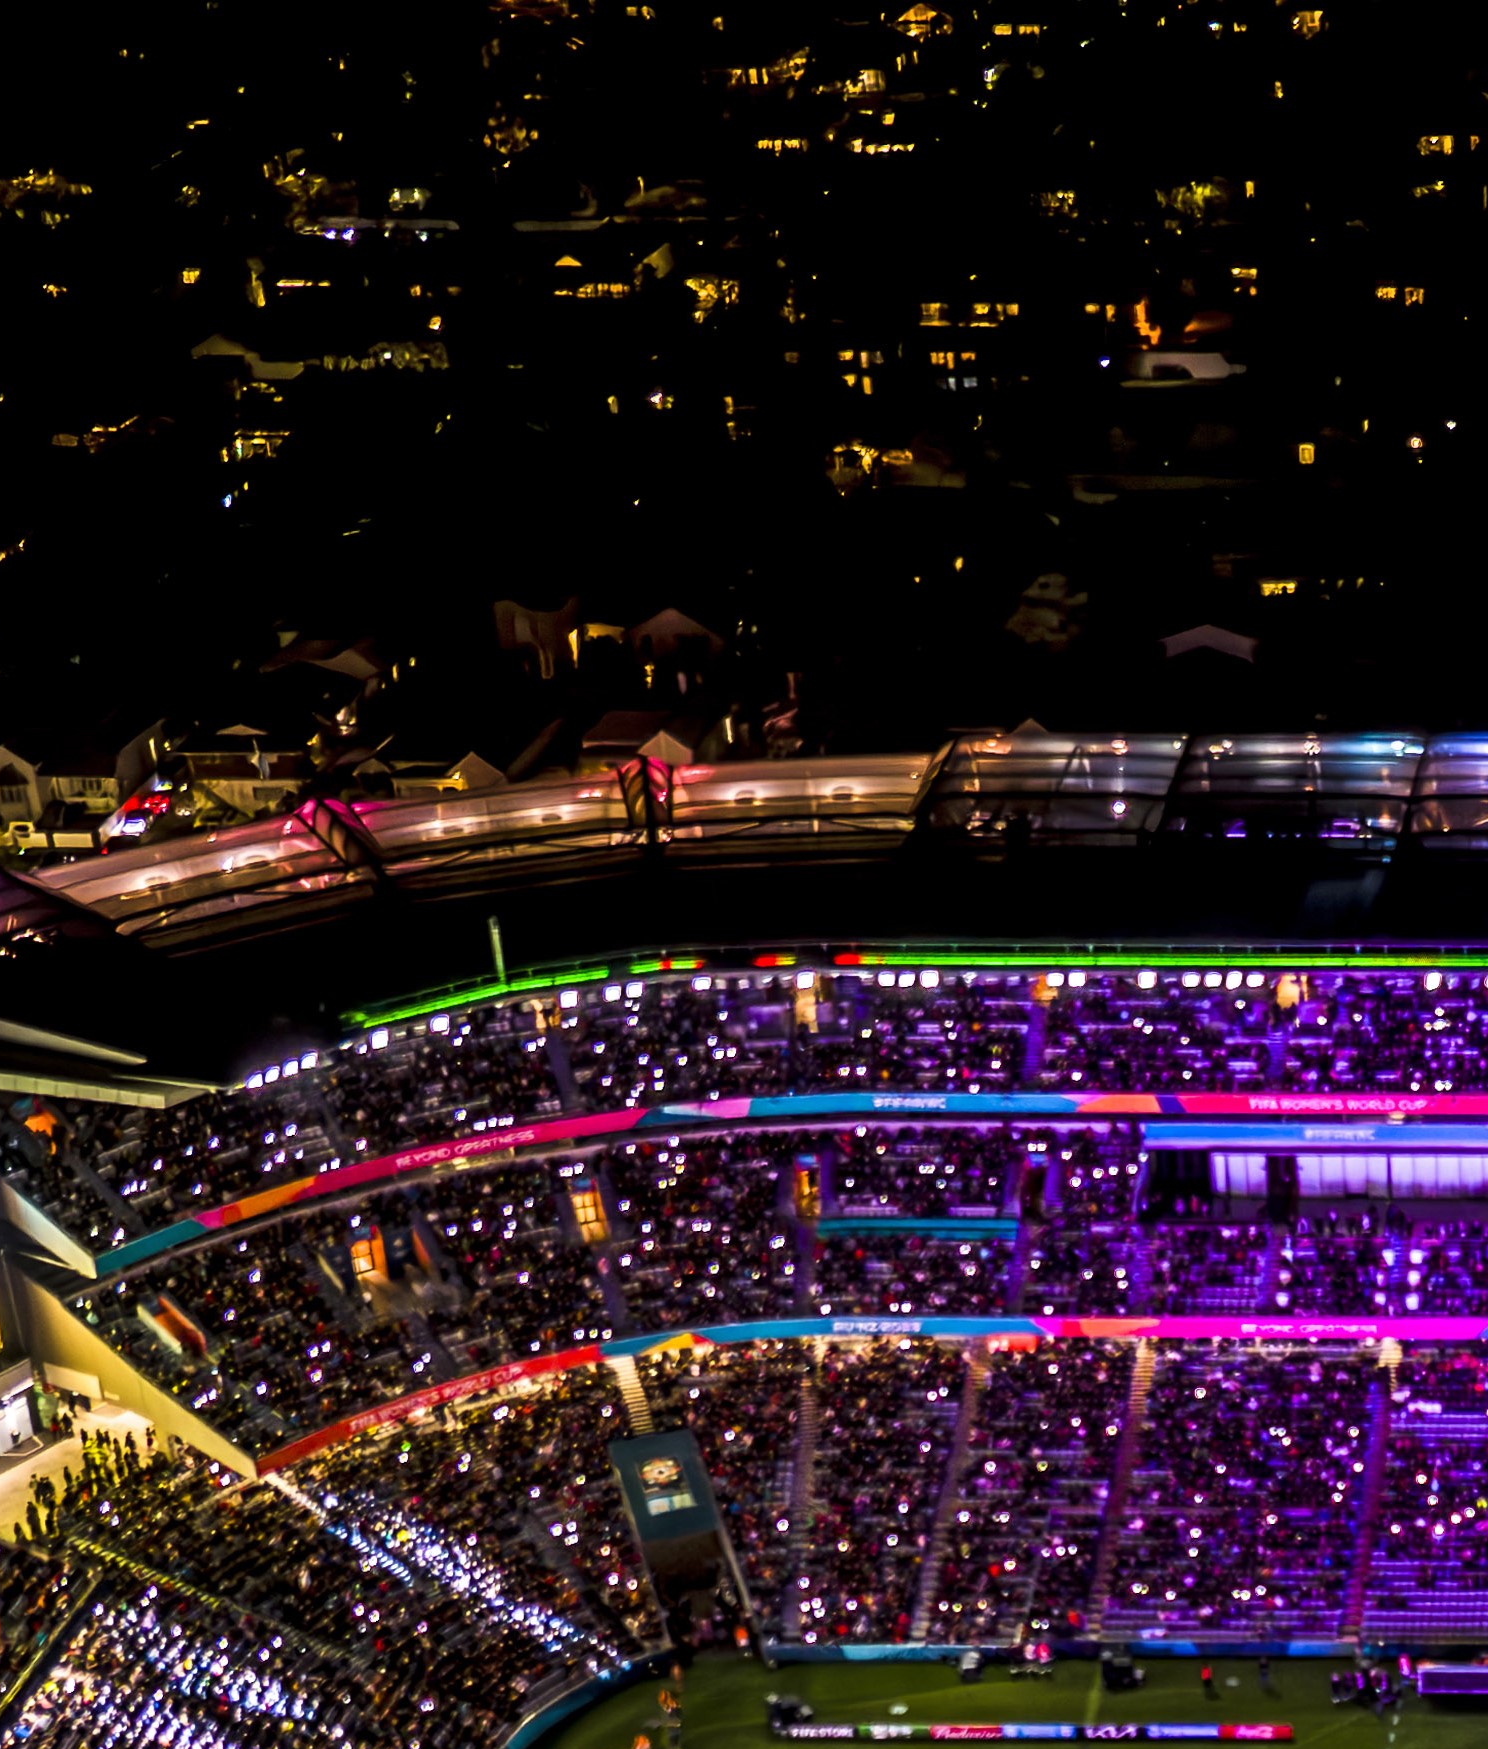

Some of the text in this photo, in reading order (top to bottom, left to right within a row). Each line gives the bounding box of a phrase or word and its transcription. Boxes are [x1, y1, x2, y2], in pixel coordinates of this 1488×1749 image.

[1248, 1098, 1427, 1110] FIFA WOMEN'S WORLD CUP
